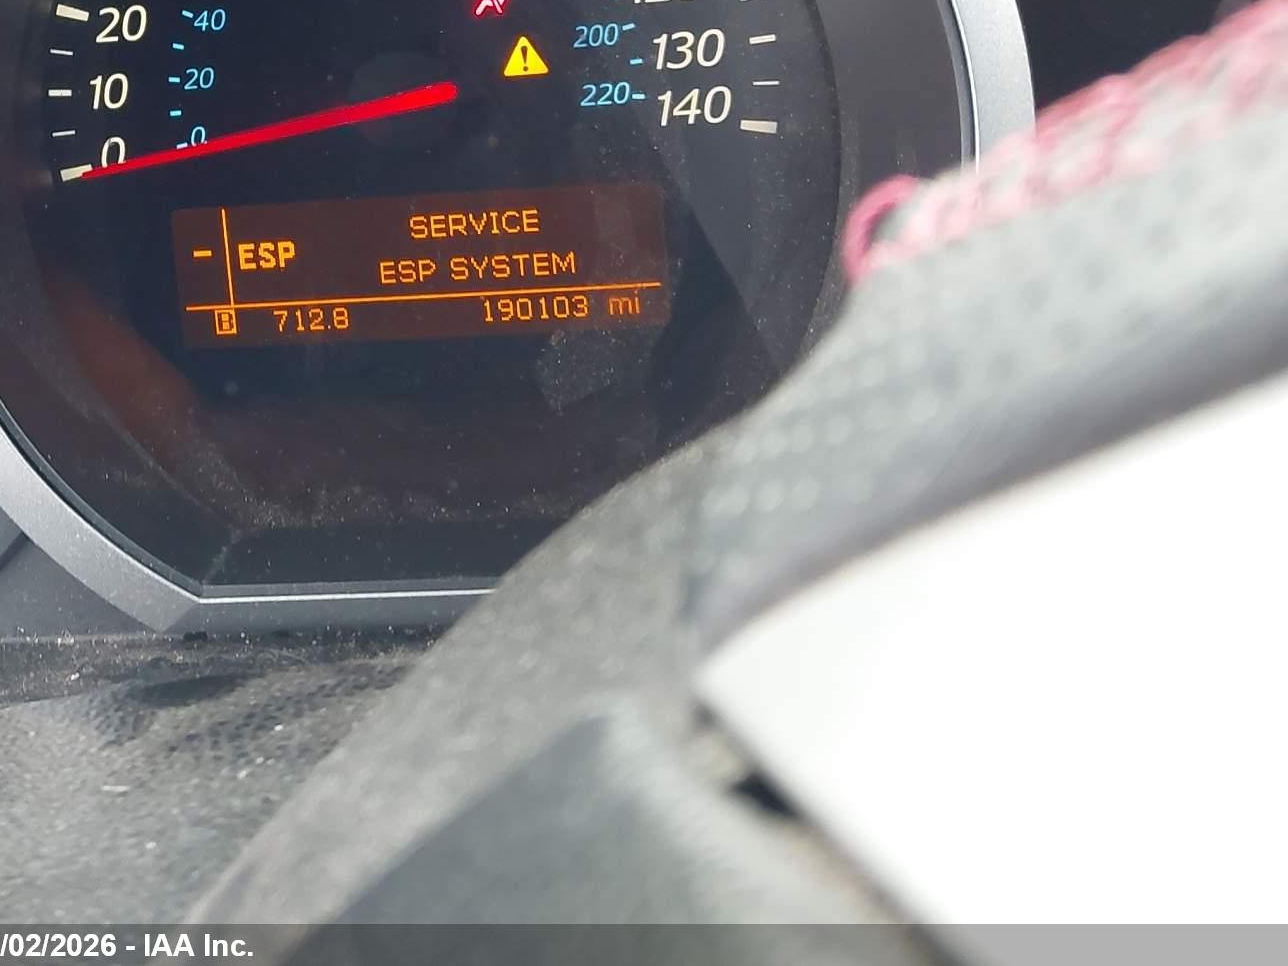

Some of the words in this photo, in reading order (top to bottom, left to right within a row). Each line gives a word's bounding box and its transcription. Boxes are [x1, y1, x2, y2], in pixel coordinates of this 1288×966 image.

[96, 5, 147, 43] 20
[194, 10, 226, 31] 40
[574, 24, 618, 48] 200
[653, 28, 725, 70] 130
[89, 74, 128, 109] 10
[184, 68, 214, 90] 20
[580, 82, 630, 107] 220
[657, 86, 732, 126] 140
[190, 127, 207, 146] 0
[101, 137, 125, 168] 0
[410, 209, 540, 239] SERVICE
[238, 241, 296, 270] ESP
[380, 259, 435, 285] ESP
[450, 252, 576, 281] SYSTEM
[273, 308, 350, 333] 712.8
[484, 296, 589, 323] 190103
[609, 293, 641, 315] mi
